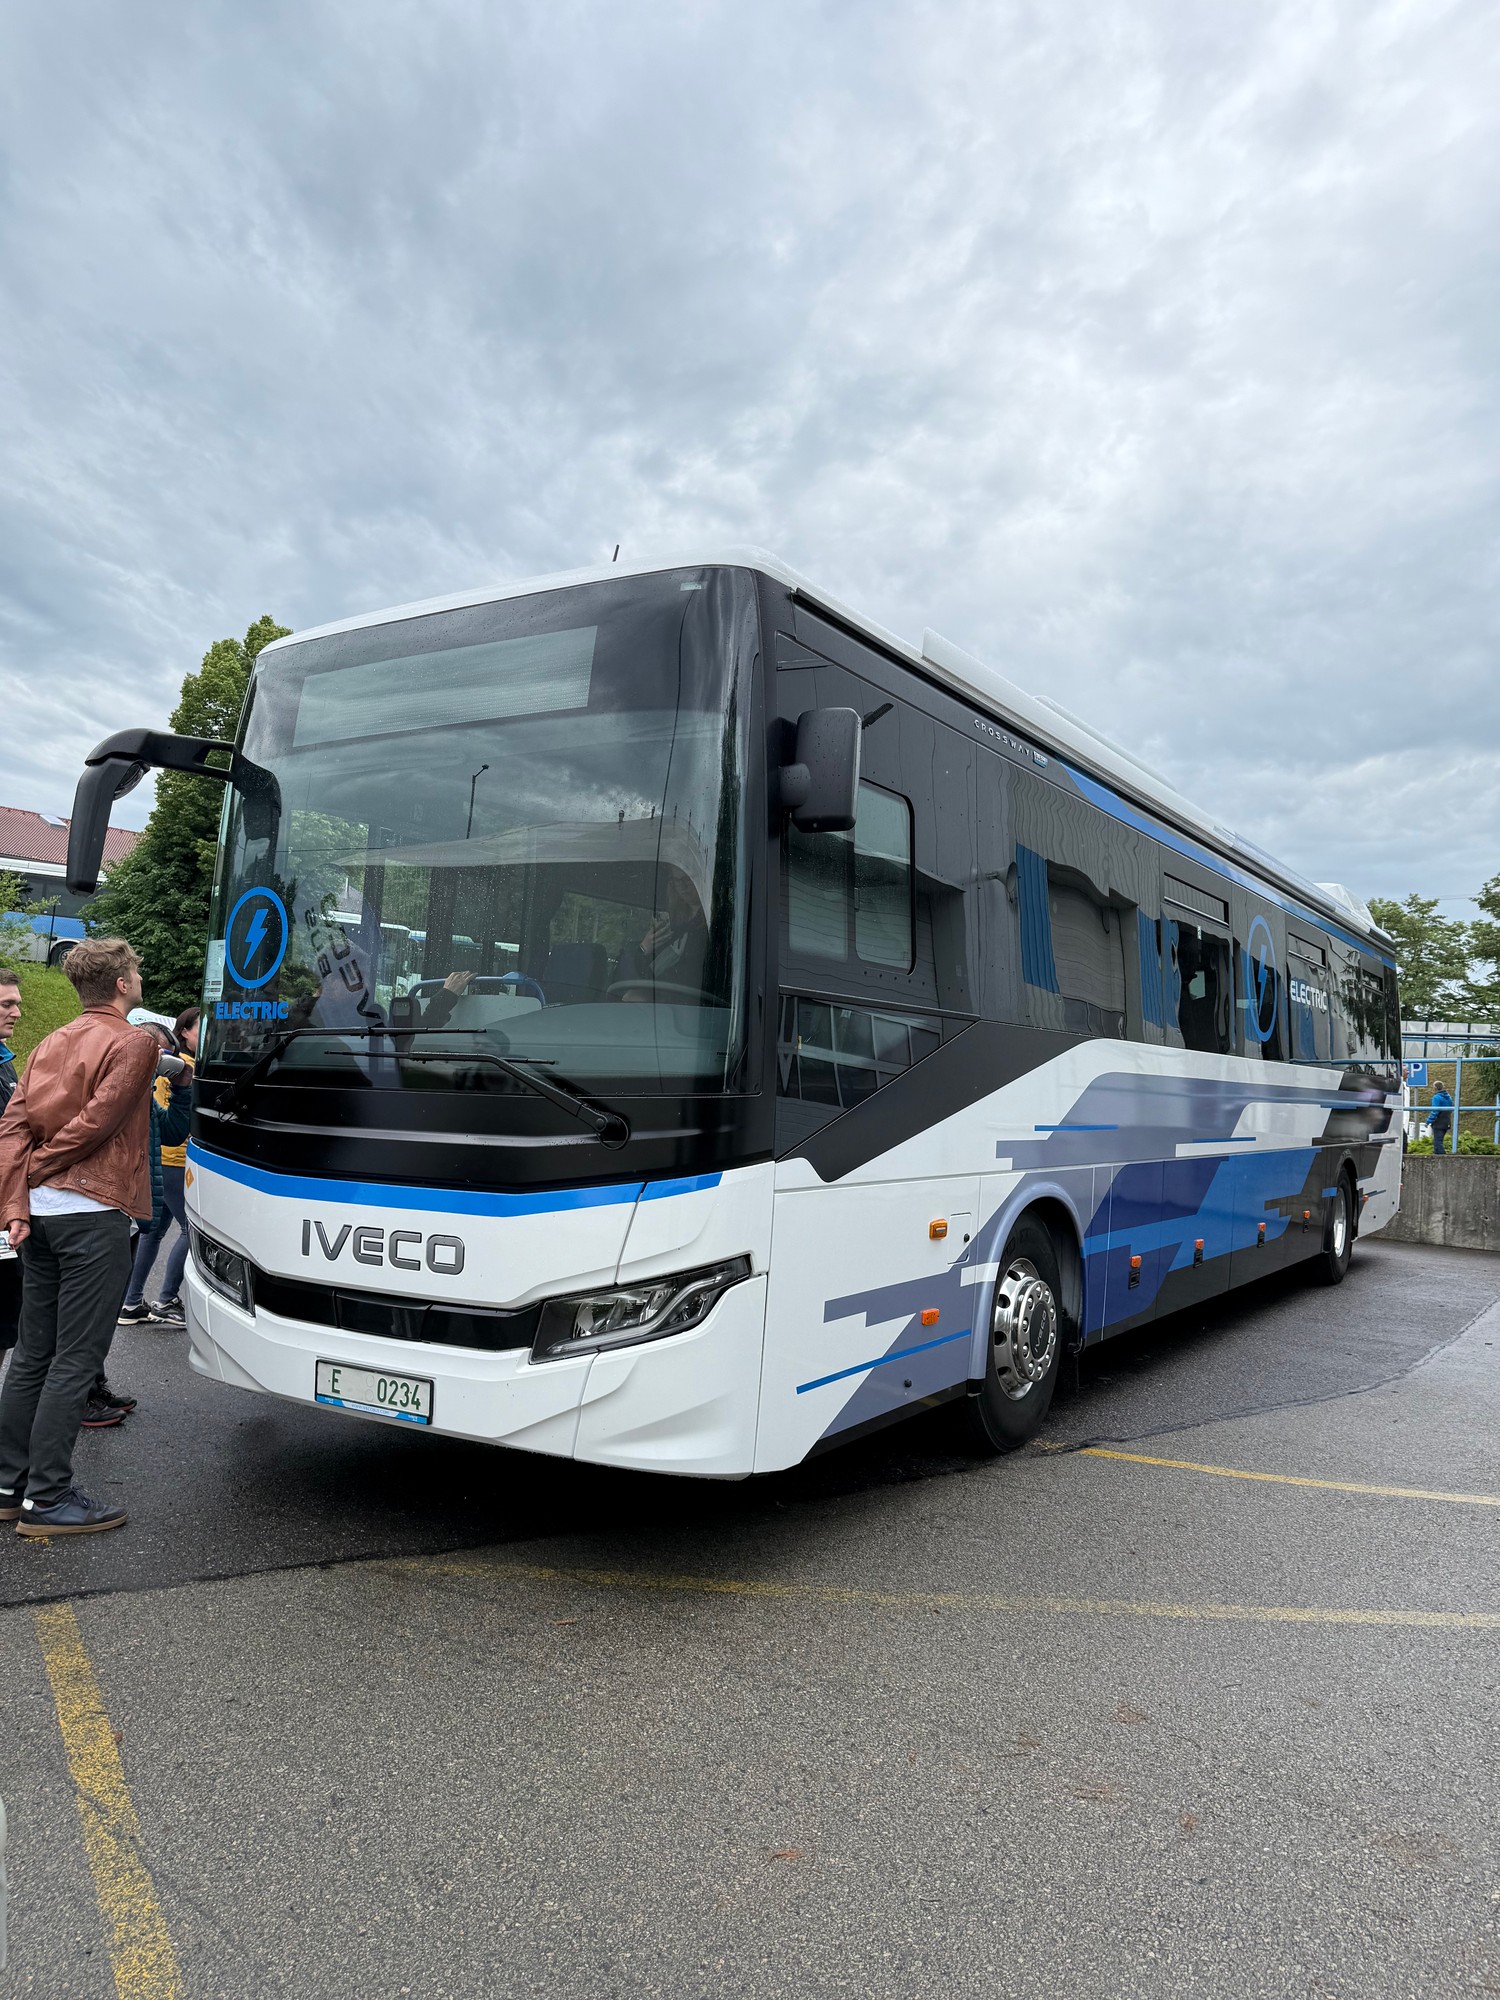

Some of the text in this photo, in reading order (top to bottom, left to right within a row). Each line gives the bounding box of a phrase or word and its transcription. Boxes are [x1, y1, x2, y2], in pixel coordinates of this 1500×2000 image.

[974, 719, 1030, 756] CROSSWAY
[215, 1001, 289, 1020] ELECTRIC
[1290, 980, 1328, 1010] ELECTRIC
[1410, 1062, 1423, 1078] P
[301, 1219, 465, 1275] IVECO
[1034, 1310, 1047, 1353] IVECO
[331, 1368, 421, 1411] E 0234
